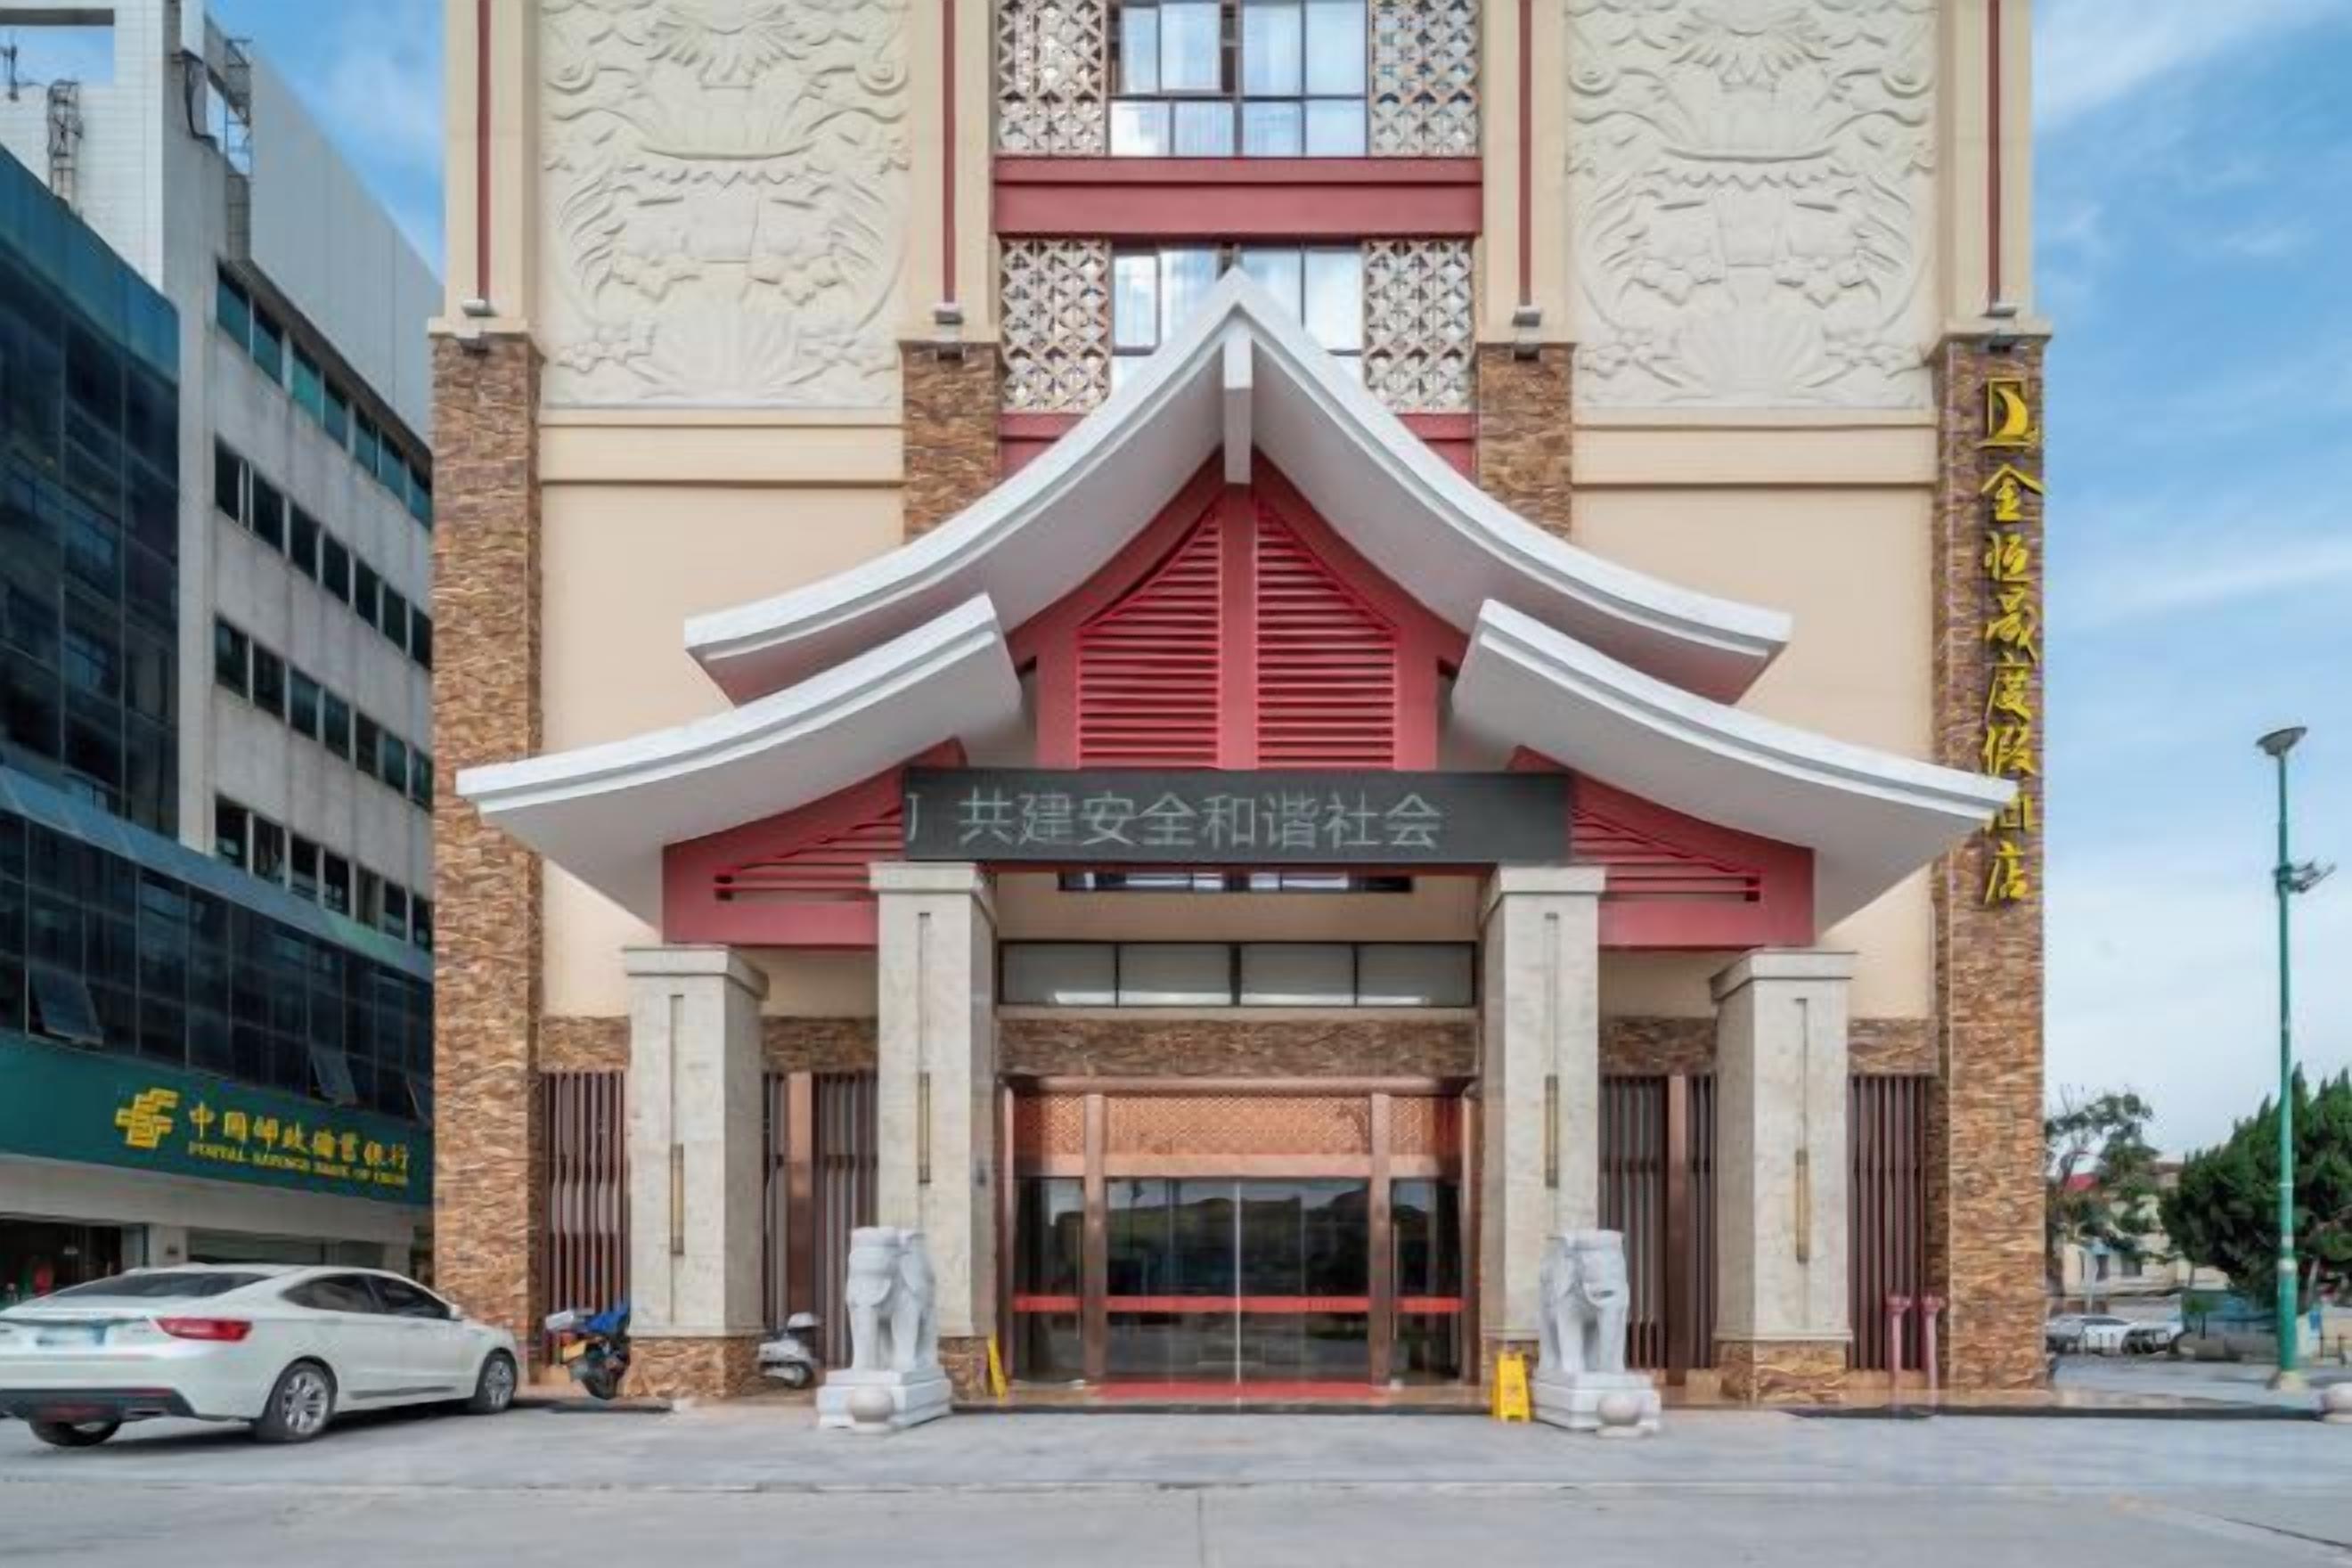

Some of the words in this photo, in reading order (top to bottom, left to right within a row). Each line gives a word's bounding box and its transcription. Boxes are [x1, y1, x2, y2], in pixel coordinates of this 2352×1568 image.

[959, 788, 1441, 848] 共建安全和谐社会
